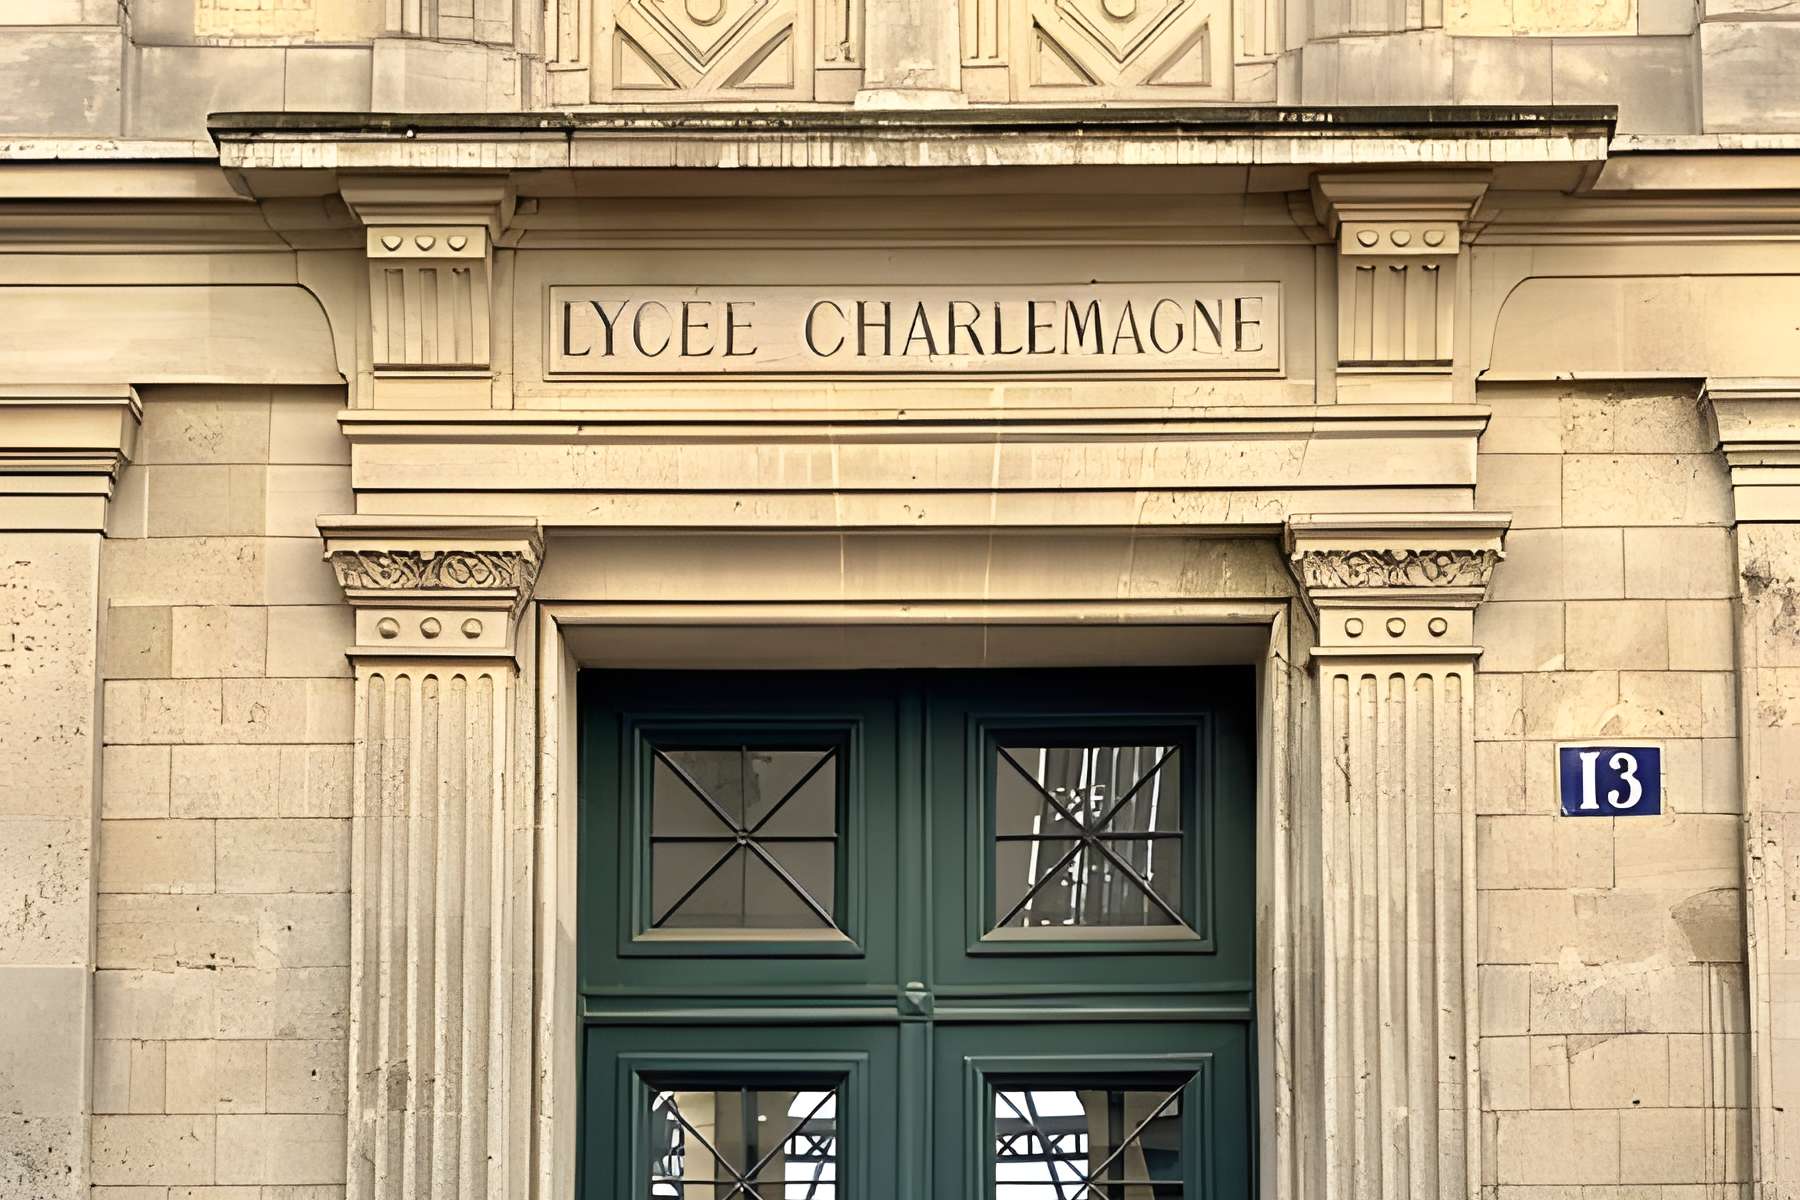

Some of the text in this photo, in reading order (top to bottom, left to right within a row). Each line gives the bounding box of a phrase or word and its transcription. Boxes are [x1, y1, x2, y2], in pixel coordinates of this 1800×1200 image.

[563, 297, 1264, 357] LYCEE CHARLEMAGNE
[1579, 751, 1643, 810] 13
